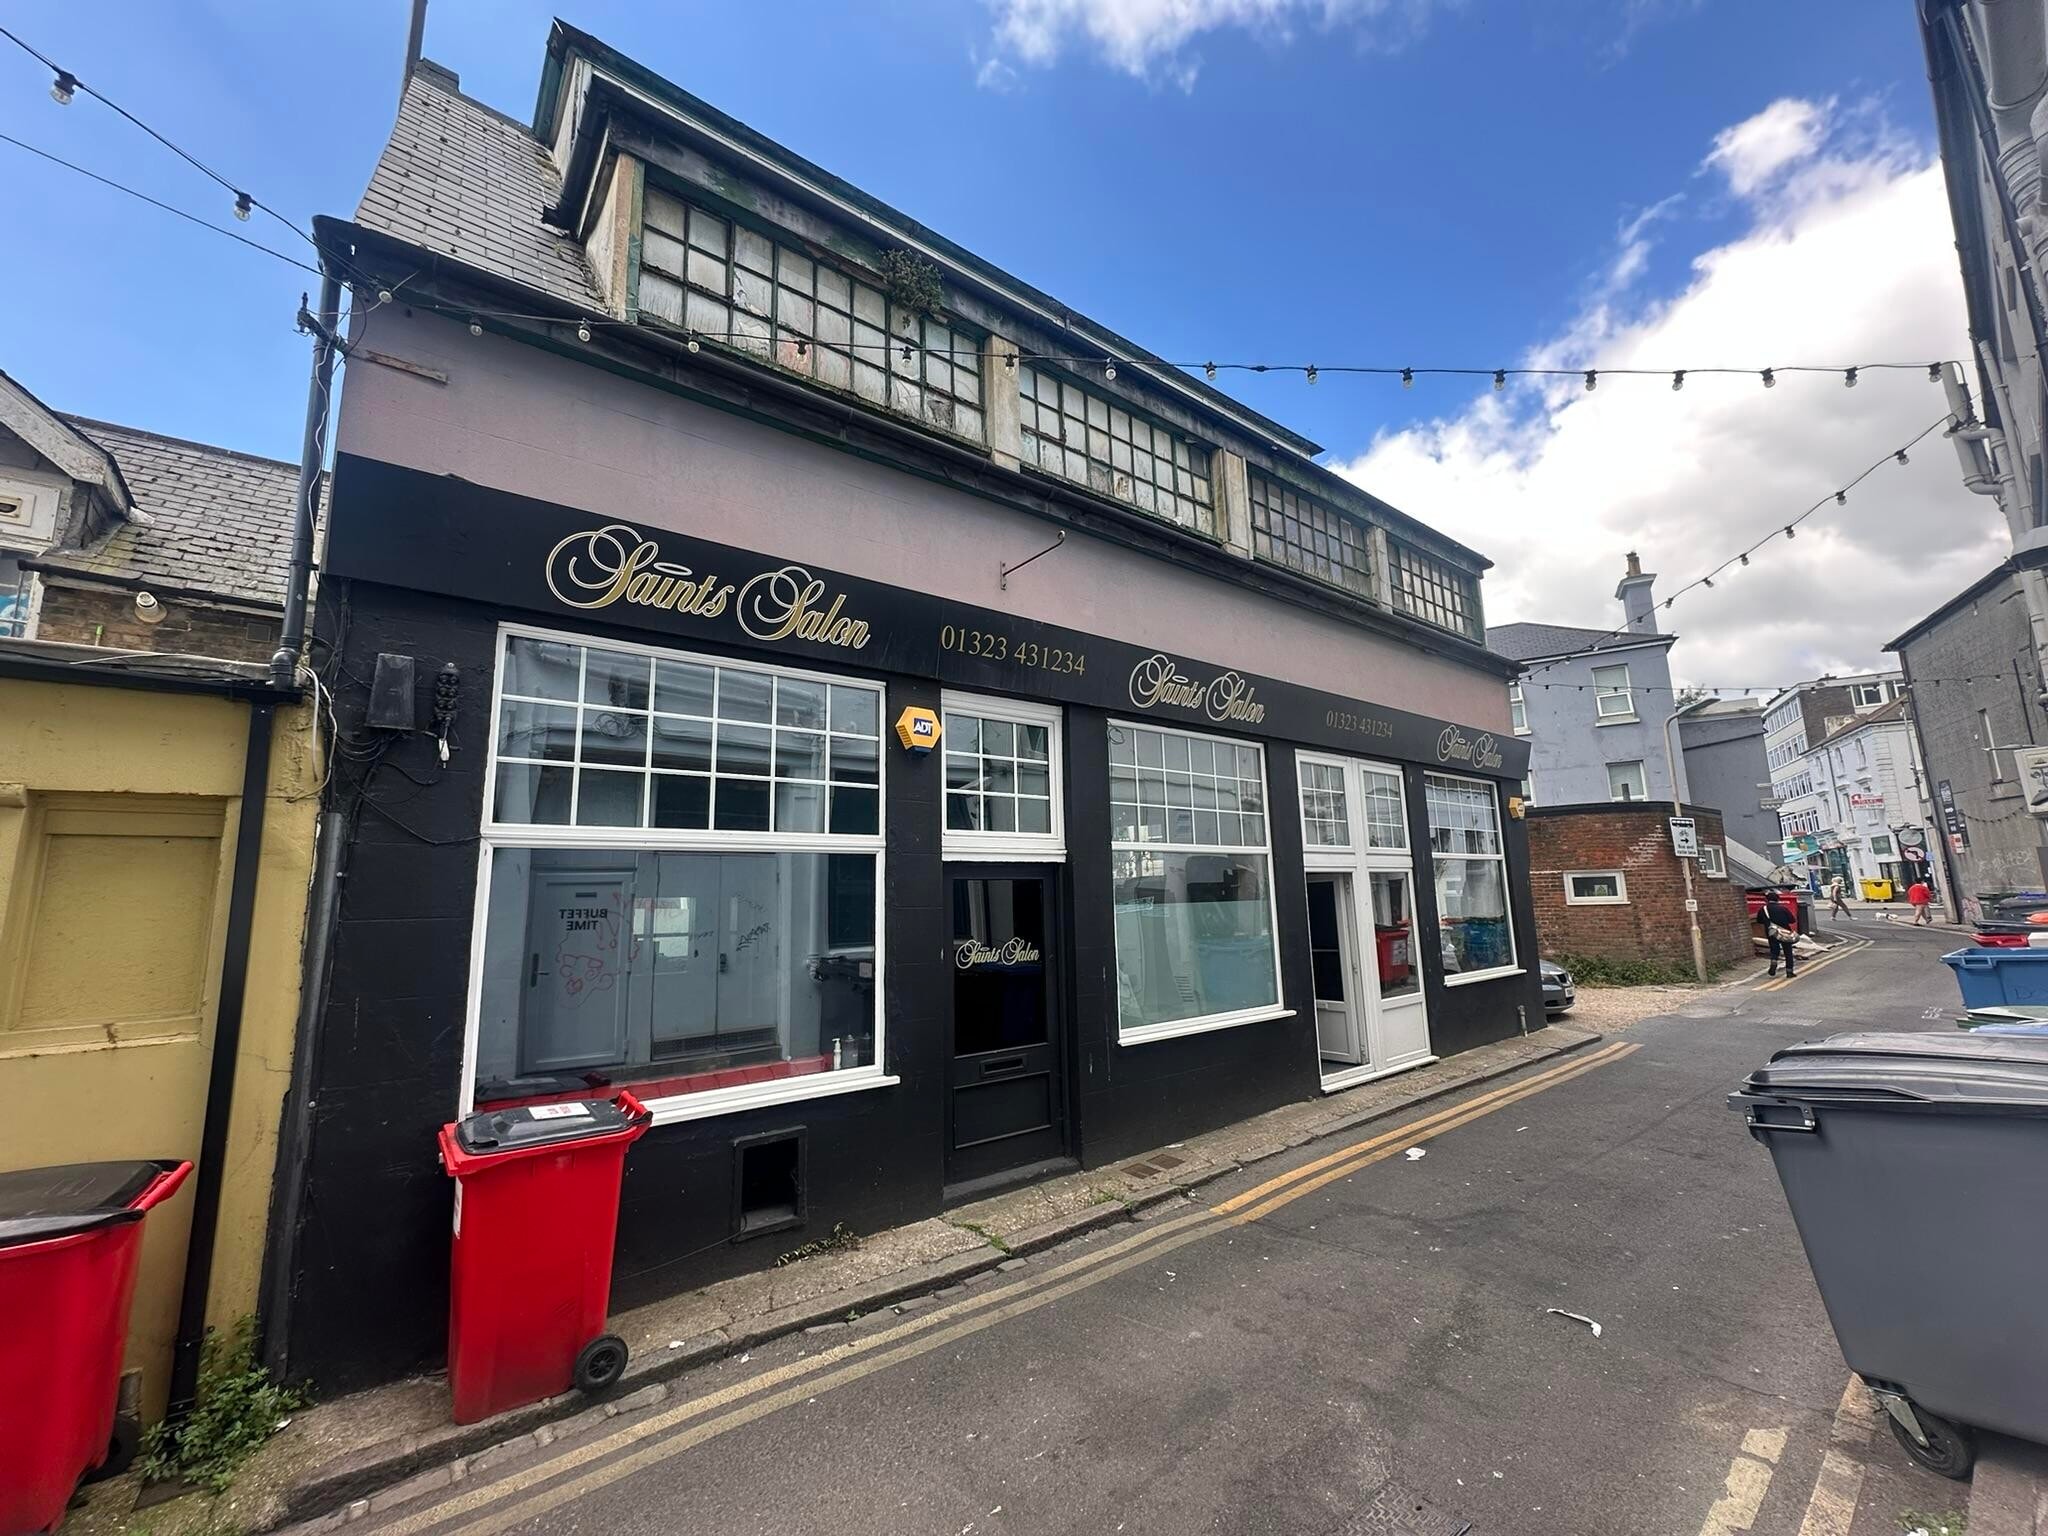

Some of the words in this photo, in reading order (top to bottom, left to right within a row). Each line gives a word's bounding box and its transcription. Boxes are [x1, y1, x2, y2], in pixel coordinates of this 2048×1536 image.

[546, 524, 735, 618] Saints
[736, 566, 871, 649] Salon
[941, 625, 1007, 660] 01323
[1014, 641, 1085, 676] 431234
[1129, 654, 1206, 709] Saints
[1206, 671, 1265, 723] Salon
[913, 720, 933, 735] ADT
[1326, 710, 1357, 731] 01323
[1359, 717, 1393, 739] 431234
[956, 939, 1000, 969] Saints
[1001, 937, 1040, 966] Salon
